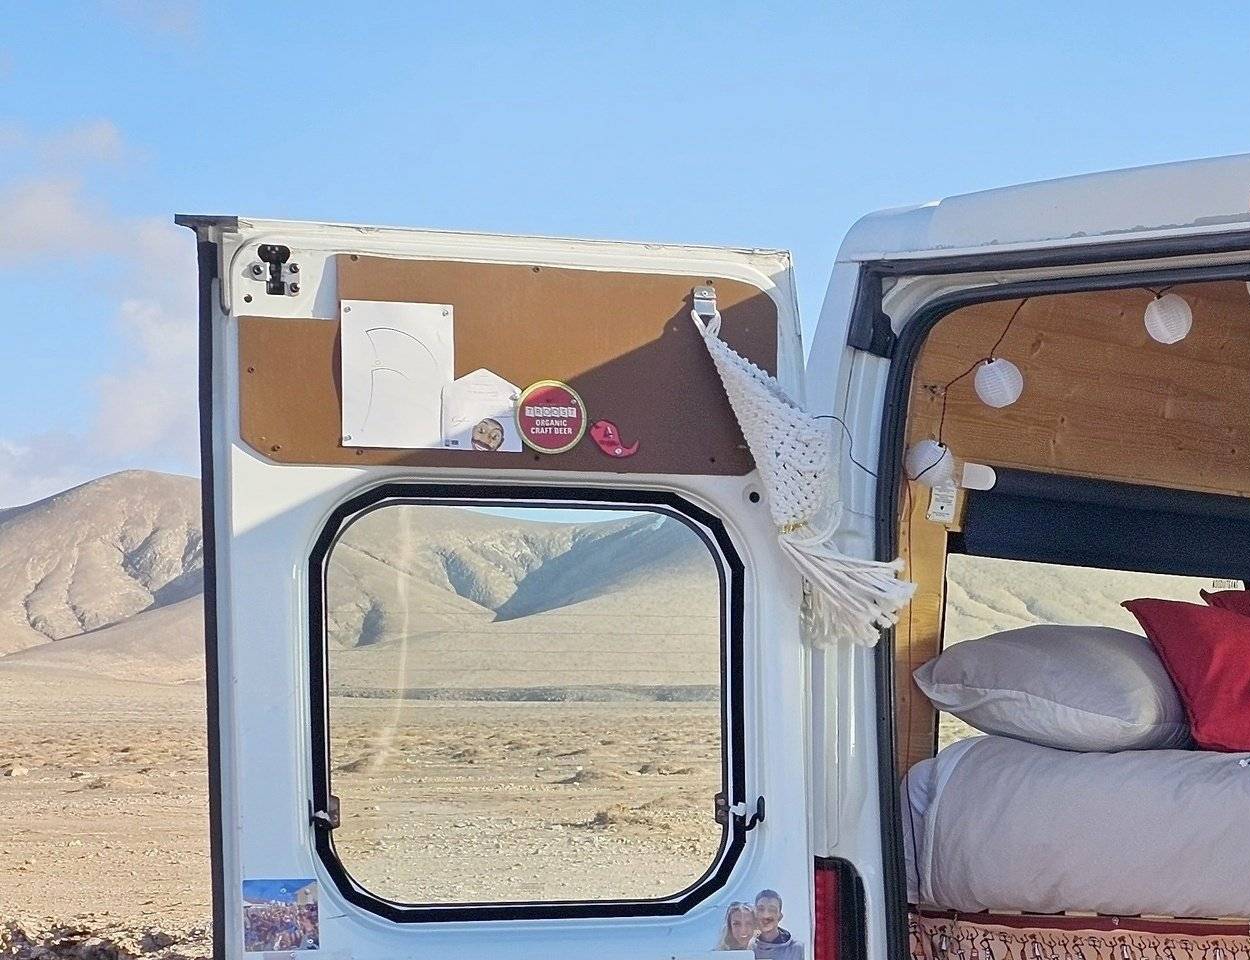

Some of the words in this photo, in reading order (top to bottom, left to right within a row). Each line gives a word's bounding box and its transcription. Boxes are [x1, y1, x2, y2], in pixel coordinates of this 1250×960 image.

[535, 419, 568, 427] ORGANIC
[530, 427, 552, 435] CRAFT
[554, 427, 573, 435] BEER
